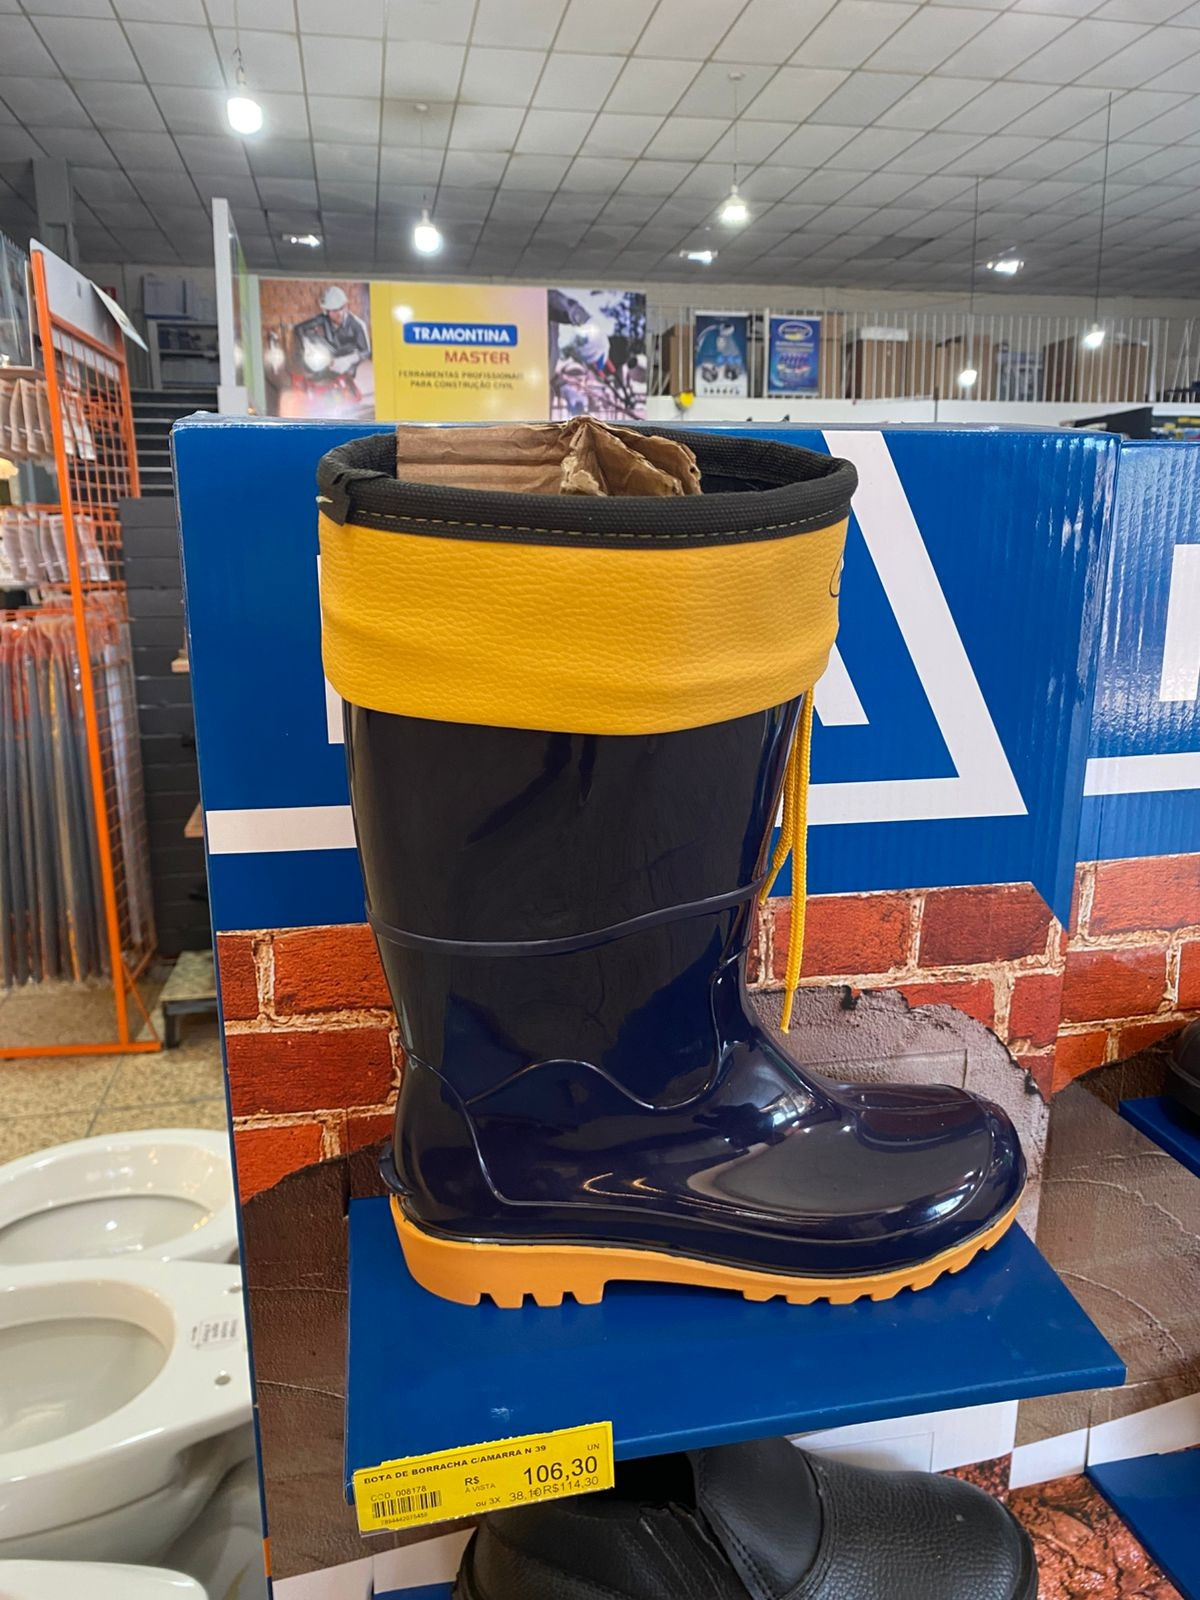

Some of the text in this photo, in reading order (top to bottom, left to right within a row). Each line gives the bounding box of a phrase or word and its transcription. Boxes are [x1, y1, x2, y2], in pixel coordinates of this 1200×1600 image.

[412, 326, 510, 343] TRAMONTINA
[444, 350, 510, 364] MASTER
[410, 380, 432, 388] PARA
[587, 1443, 600, 1452] UN
[364, 1445, 546, 1485] BOTA DE BORRACHA C/AMARRA N 39
[464, 1455, 598, 1486] R$ 106,30
[395, 1485, 427, 1497] 008178
[472, 1482, 497, 1493] VISTA
[489, 1496, 501, 1505] 3X
